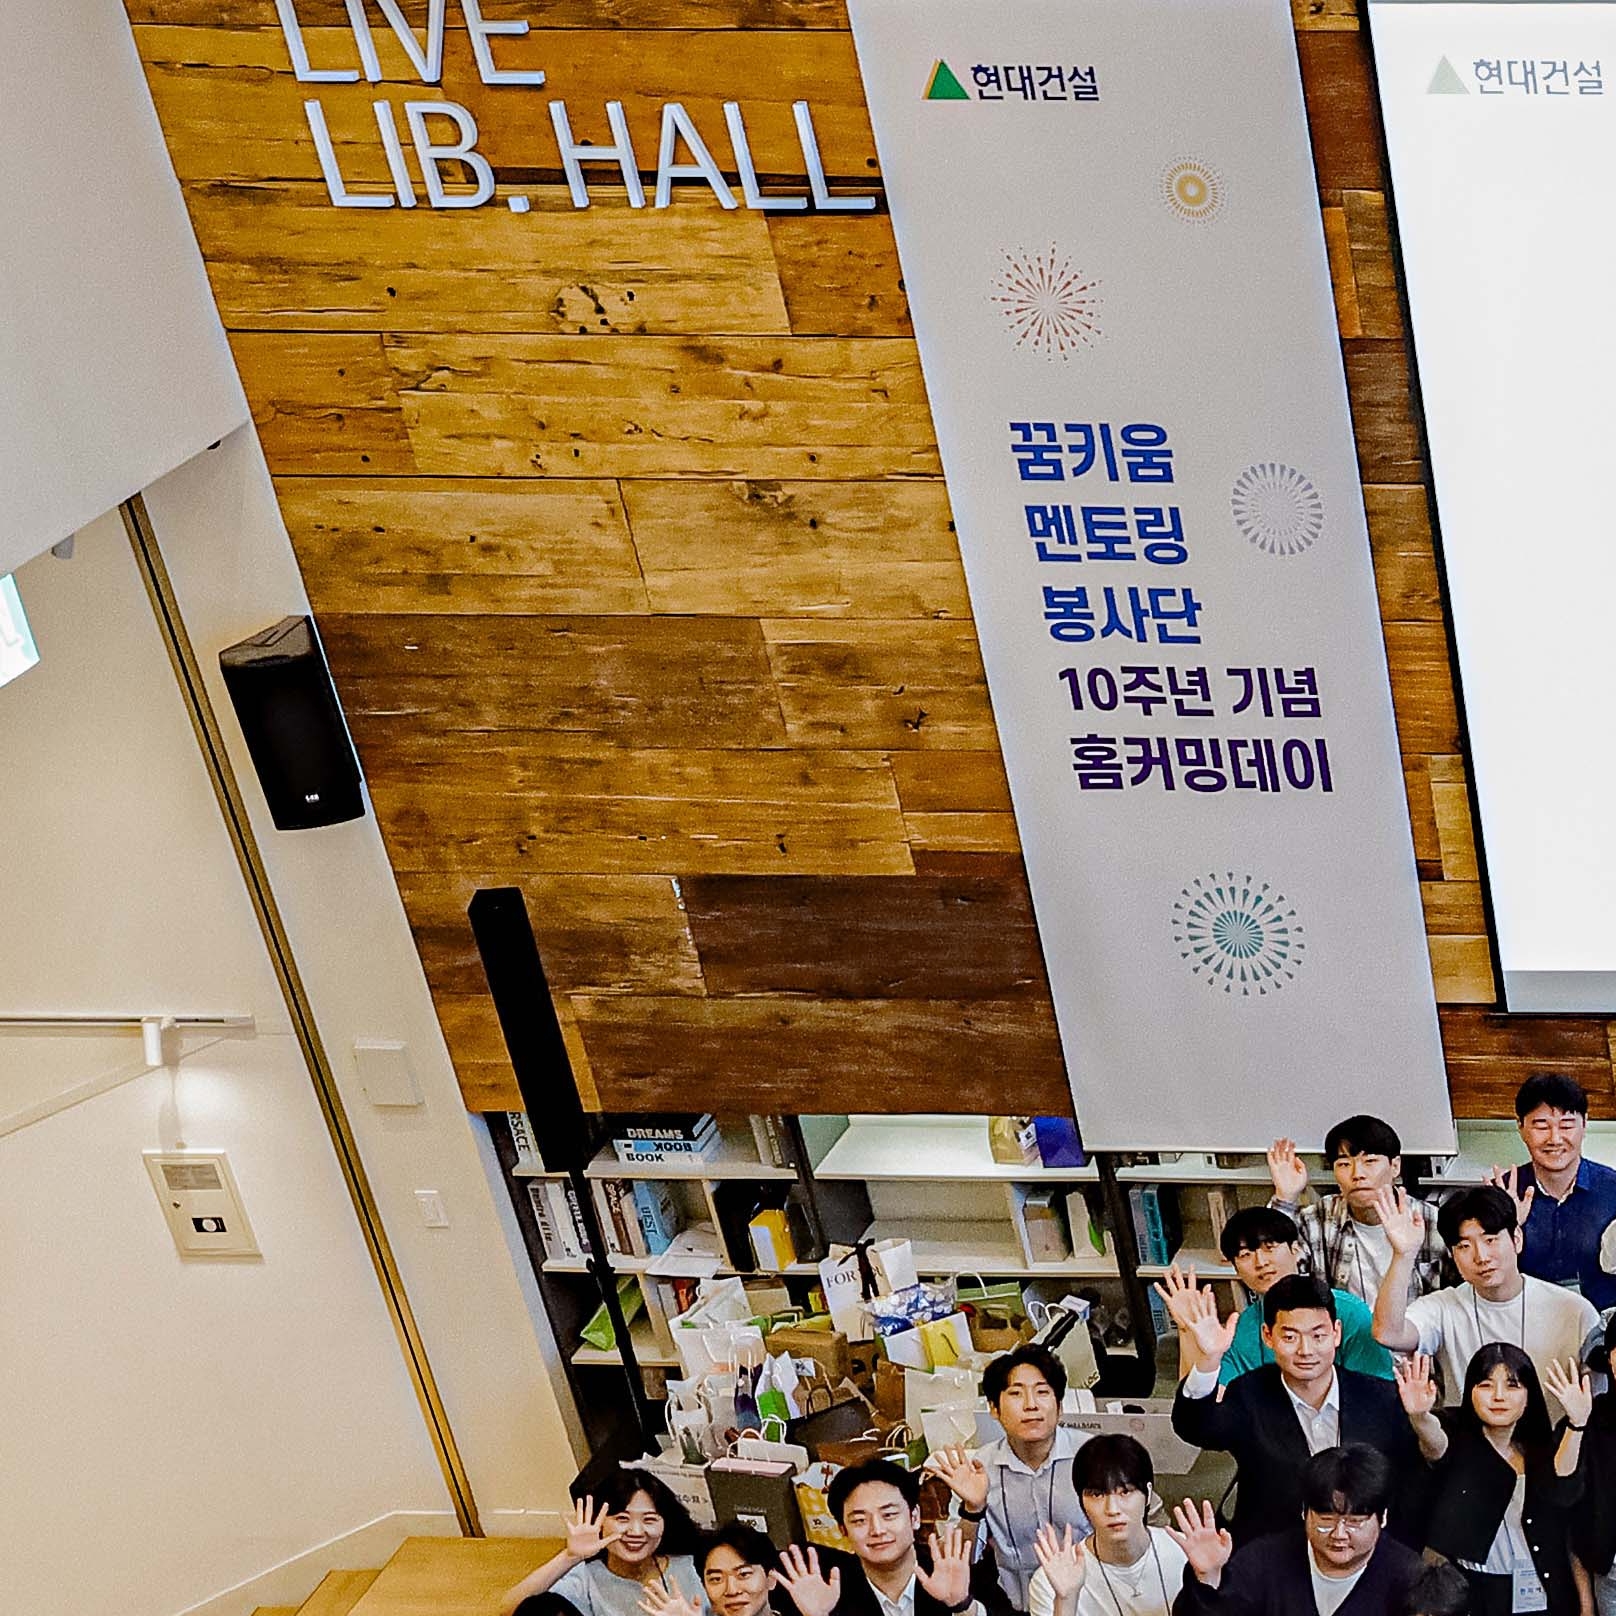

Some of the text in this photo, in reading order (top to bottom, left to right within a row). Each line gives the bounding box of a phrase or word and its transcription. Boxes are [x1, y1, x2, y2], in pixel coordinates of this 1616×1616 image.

[276, 0, 546, 86] LIVE
[971, 61, 1100, 103] 현대건설
[1473, 58, 1604, 97] 현대건설
[304, 99, 877, 212] LIB. HALL
[1009, 420, 1175, 485] 꿈키움
[1024, 504, 1189, 567] 멘토링
[1042, 585, 1203, 647] 봉사단
[1058, 665, 1323, 720] 10주년 기념
[1070, 734, 1334, 794] 홈커밍데이
[508, 1111, 530, 1151] RSACE
[626, 1127, 684, 1140] DREAMS
[626, 1153, 665, 1162] BOOK
[826, 1270, 857, 1289] FOR
